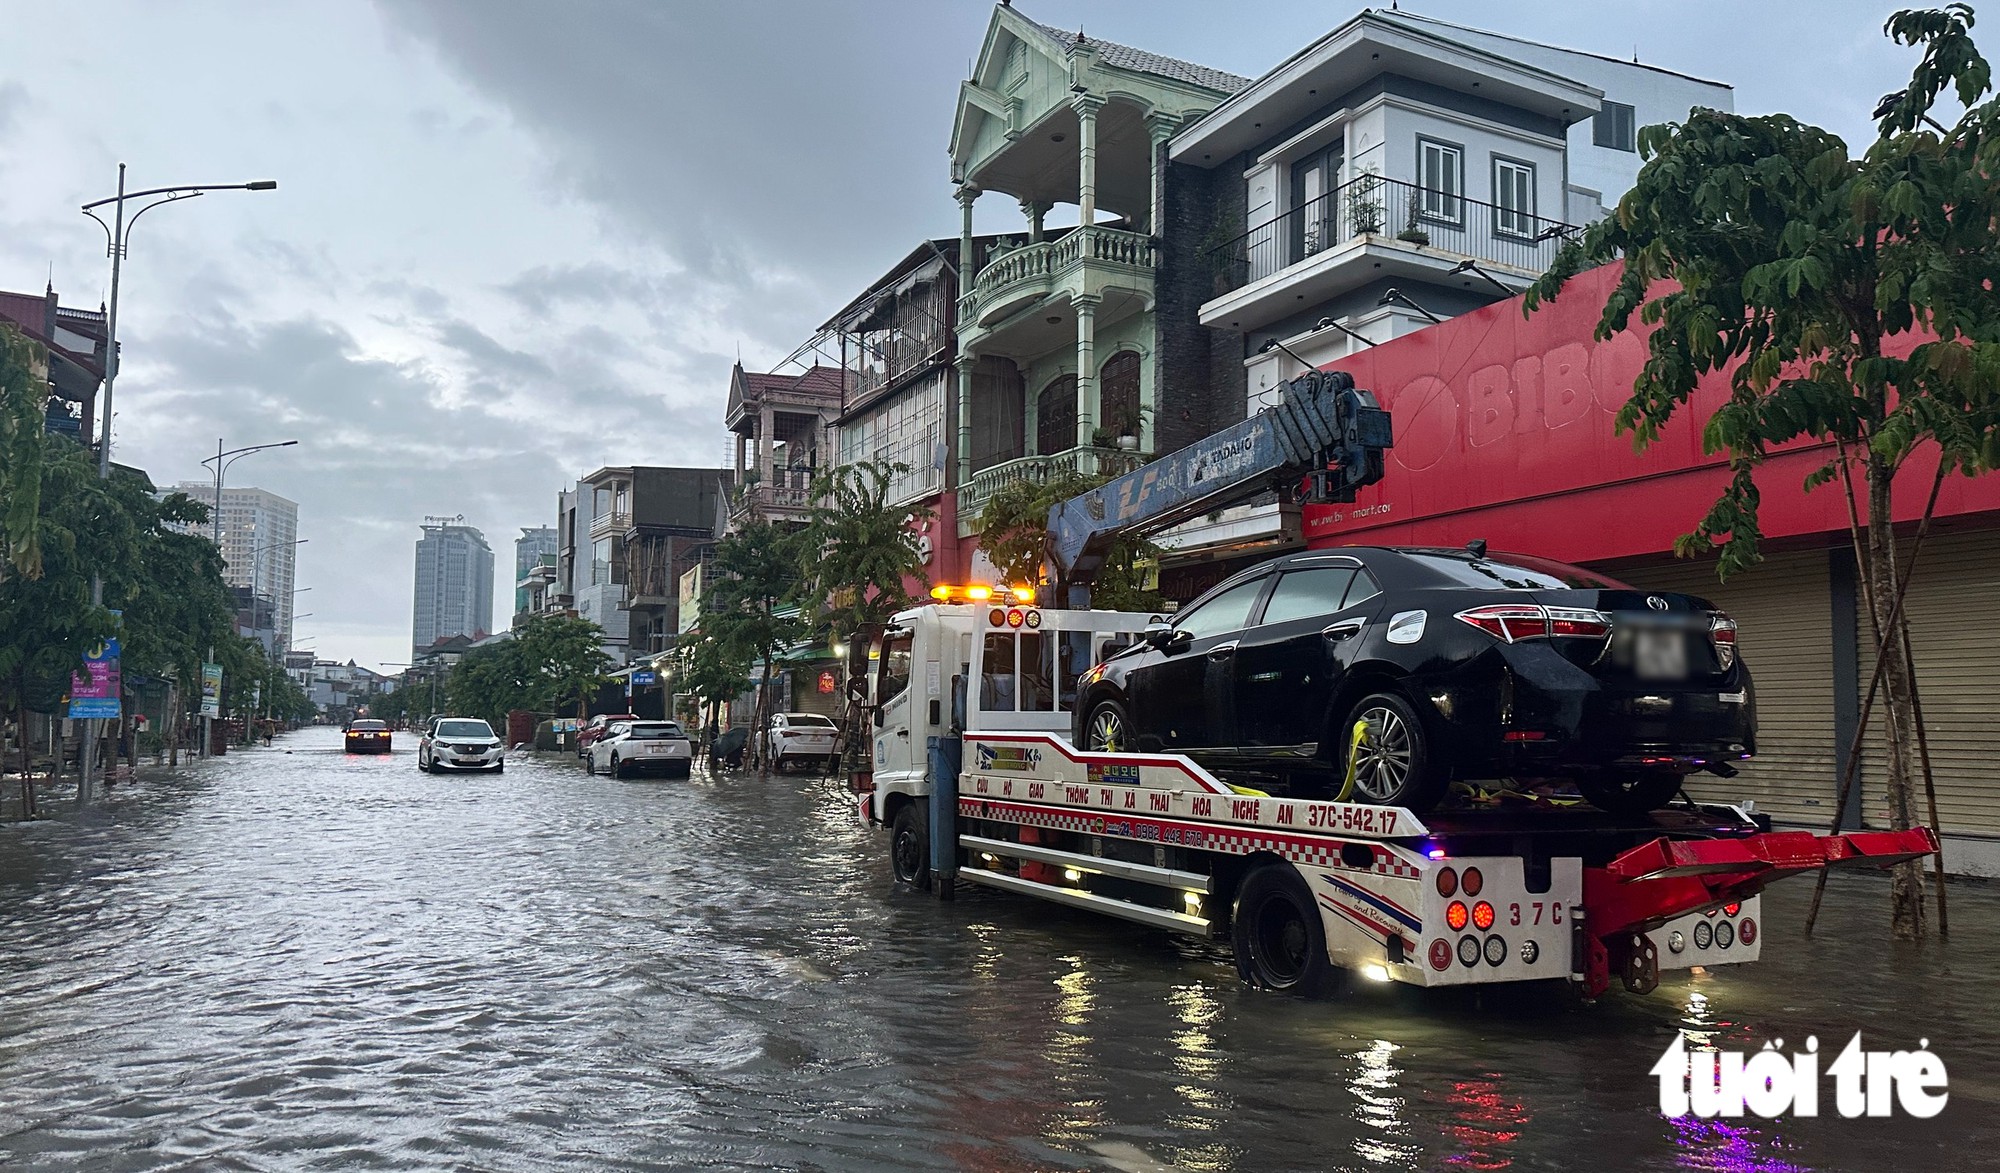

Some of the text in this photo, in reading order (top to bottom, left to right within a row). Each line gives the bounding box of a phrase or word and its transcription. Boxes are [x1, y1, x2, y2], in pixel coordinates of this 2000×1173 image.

[1029, 783, 1044, 799] GIAO
[1065, 785, 1089, 804] THÔNG
[1100, 788, 1113, 808] THỊ
[1150, 791, 1170, 811] THÁI
[1192, 794, 1211, 817] HÒA
[1232, 798, 1260, 824] NGHỆ
[1277, 804, 1294, 825] AN
[1308, 804, 1397, 834] 37C-542.17
[1135, 823, 1159, 840] 0982
[1163, 827, 1182, 844] 442
[1184, 829, 1203, 846] 678
[1353, 904, 1404, 934] and Recovery
